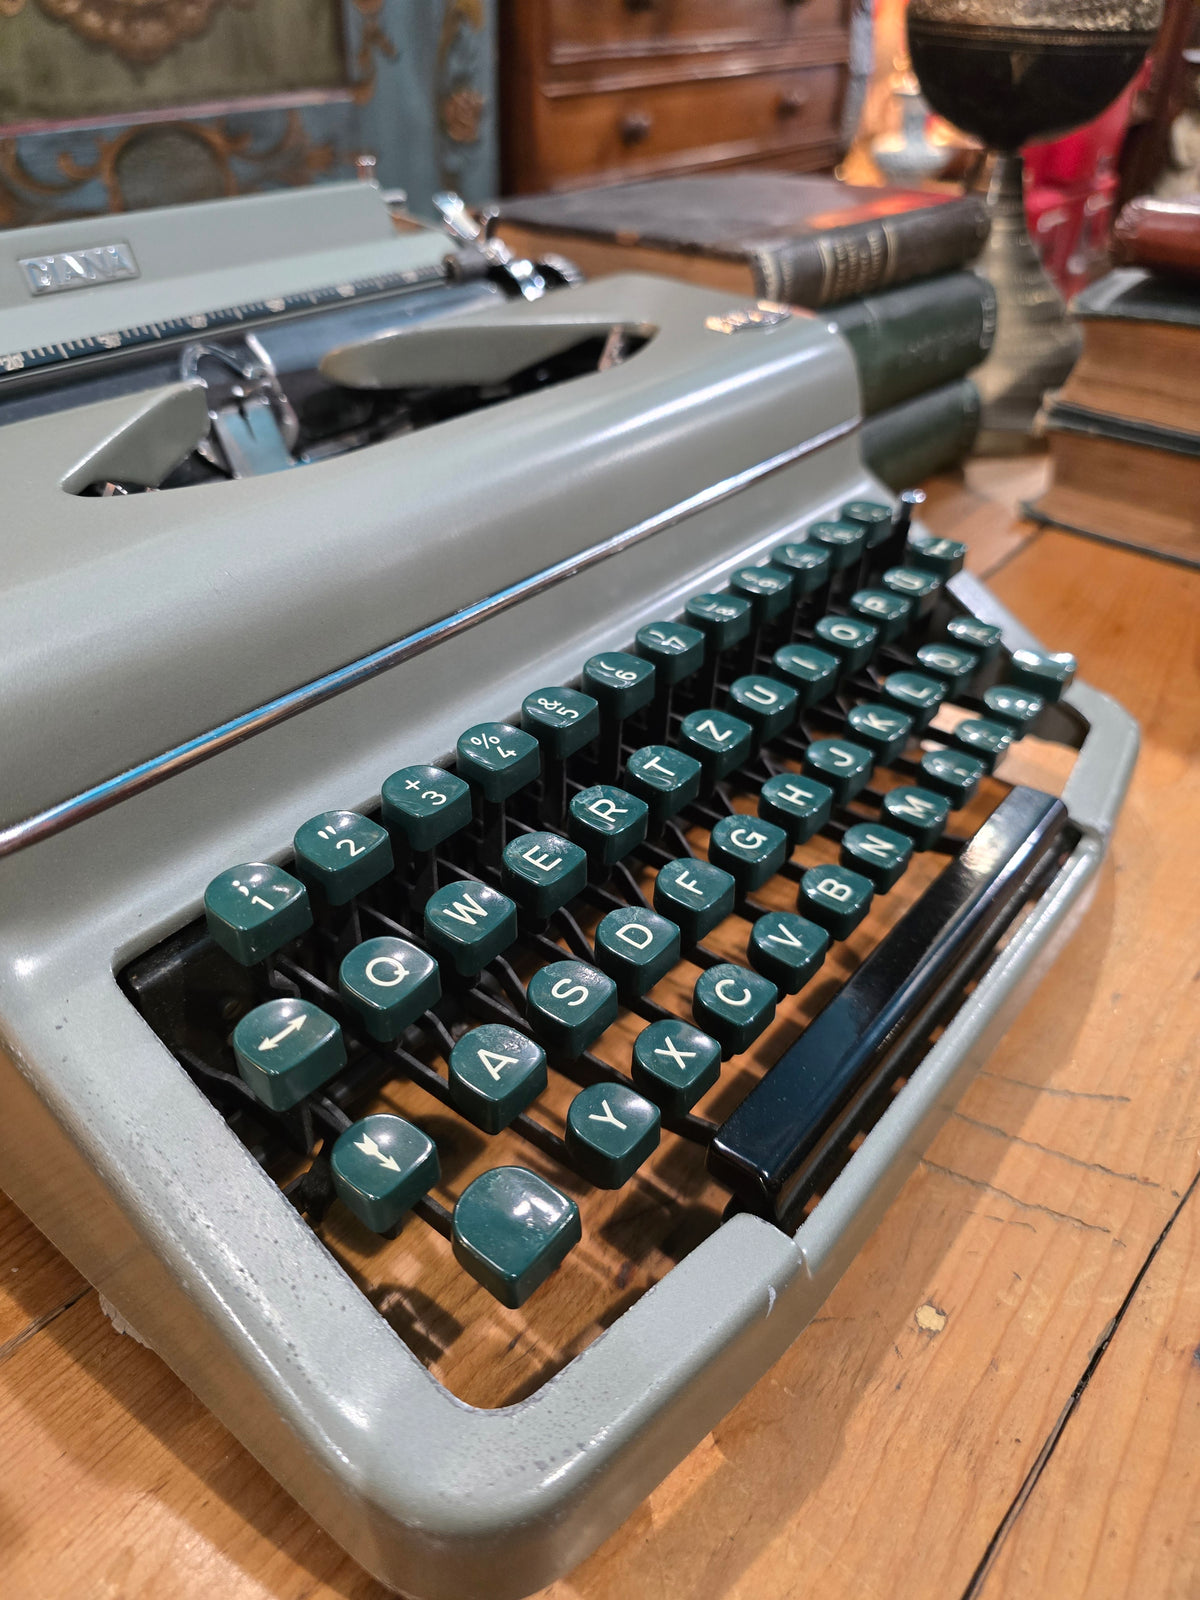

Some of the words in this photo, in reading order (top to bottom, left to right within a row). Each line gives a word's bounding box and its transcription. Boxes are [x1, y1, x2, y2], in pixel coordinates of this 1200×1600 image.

[715, 606, 737, 616] 8
[863, 597, 886, 613] P
[661, 635, 687, 648] 7
[830, 624, 859, 641] O
[791, 656, 817, 671] I
[614, 669, 638, 681] 6
[744, 685, 778, 705] U
[904, 685, 931, 699] L
[537, 697, 562, 711] &
[558, 706, 579, 719] 5
[697, 719, 733, 742] Z
[864, 713, 895, 732] K
[470, 733, 500, 751] %
[496, 745, 517, 759] 4
[642, 756, 676, 777] T
[830, 747, 854, 767] J
[421, 790, 447, 806] 3
[777, 783, 813, 806] H
[587, 798, 628, 823] R
[897, 795, 933, 819] M
[335, 838, 366, 857] 2
[730, 828, 768, 850] G
[856, 834, 895, 858] N
[521, 842, 564, 872] E
[674, 870, 703, 895] F
[816, 878, 852, 902] B
[251, 895, 275, 911] 1
[442, 891, 491, 926] W
[615, 923, 654, 950] D
[765, 923, 803, 948] V
[365, 953, 411, 987] Q
[551, 977, 591, 1007] S
[714, 978, 752, 1006] C
[653, 1035, 699, 1070] X
[476, 1046, 521, 1081] A
[588, 1098, 629, 1130] Y
